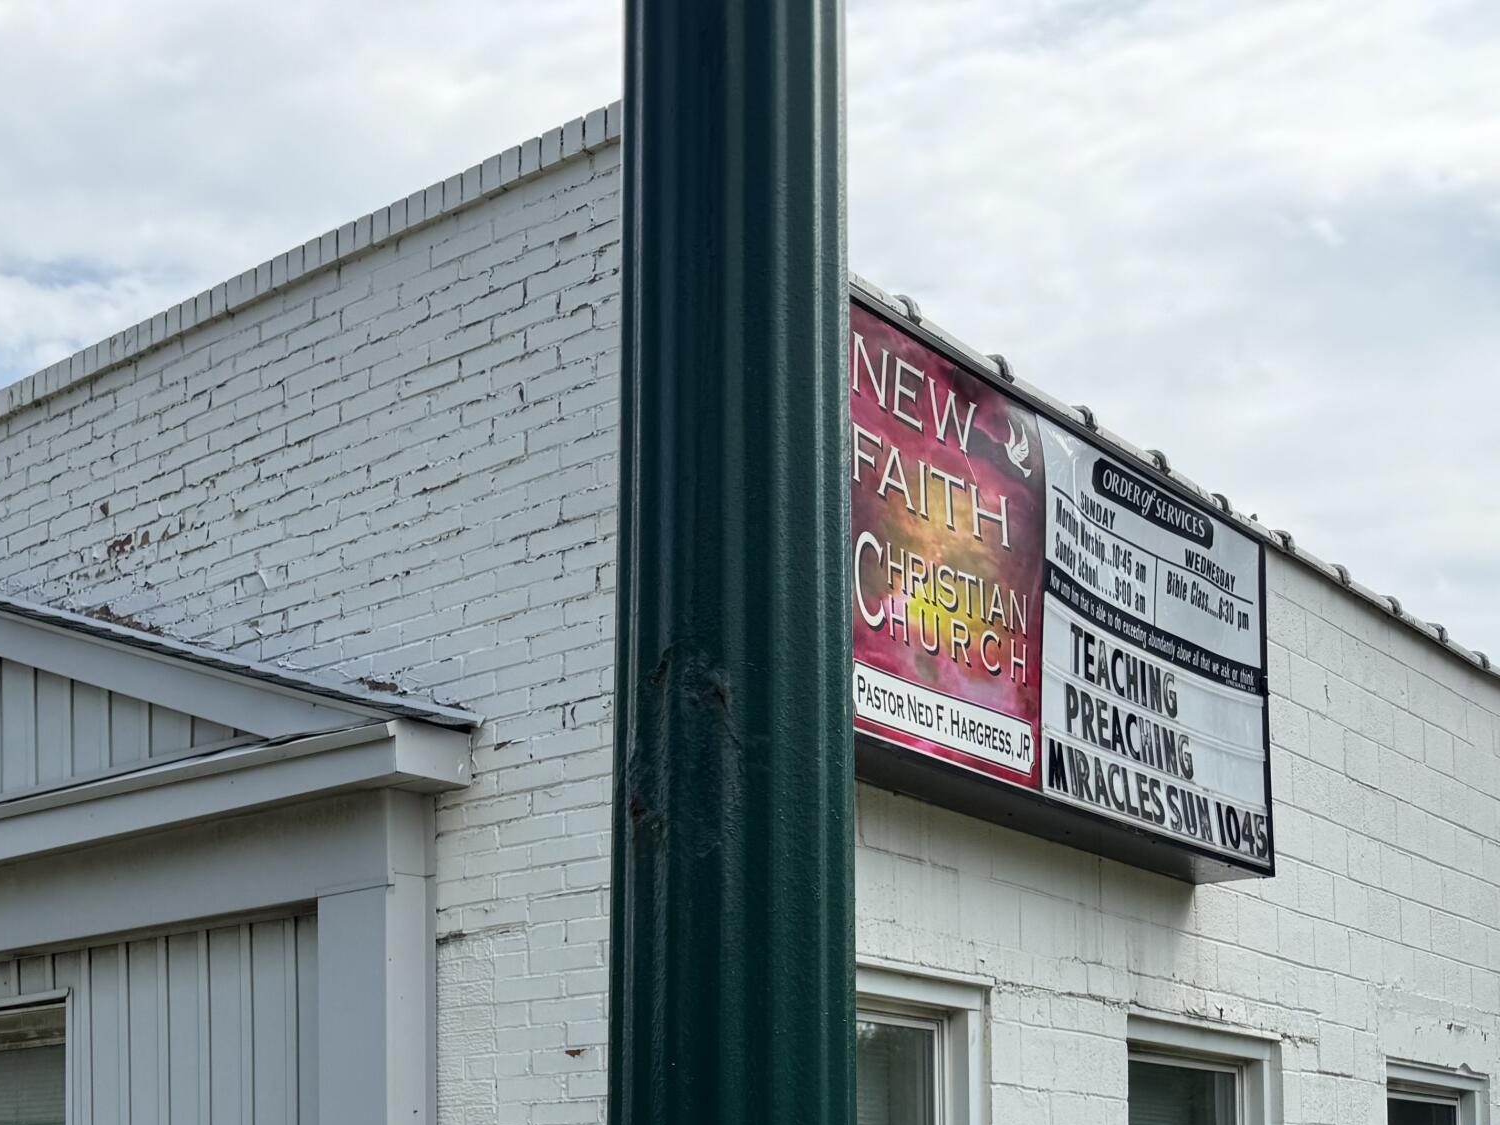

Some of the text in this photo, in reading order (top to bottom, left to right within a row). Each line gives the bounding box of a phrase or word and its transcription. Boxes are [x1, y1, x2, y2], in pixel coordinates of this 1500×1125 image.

[852, 331, 978, 455] NEW
[852, 422, 1011, 549] FAITH
[1080, 491, 1116, 530] SUNDAY
[1103, 469, 1206, 538] ORDER of SERVICES
[1055, 531, 1076, 576] Sunday
[1135, 592, 1146, 615] am
[1056, 497, 1078, 546] Morning
[1135, 561, 1147, 584] am
[1185, 548, 1236, 592] WEDNESDAY
[854, 531, 1028, 639] CHRISTIAN
[1166, 571, 1188, 601] Bible
[1237, 610, 1249, 632] pm
[1070, 622, 1178, 719] TEACHING
[1107, 611, 1113, 627] to
[1114, 613, 1122, 631] do
[1122, 620, 1147, 649] exceeding
[1148, 630, 1176, 661] abundantly
[1176, 643, 1192, 664] above
[1200, 653, 1211, 672] that
[1212, 661, 1219, 676] we
[1220, 662, 1230, 679] ask
[1231, 668, 1238, 681] or
[1240, 668, 1254, 687] think
[857, 675, 905, 720] PASTOR
[936, 704, 948, 735] F.
[1016, 733, 1032, 763] JR
[1065, 682, 1194, 781] PREACHING
